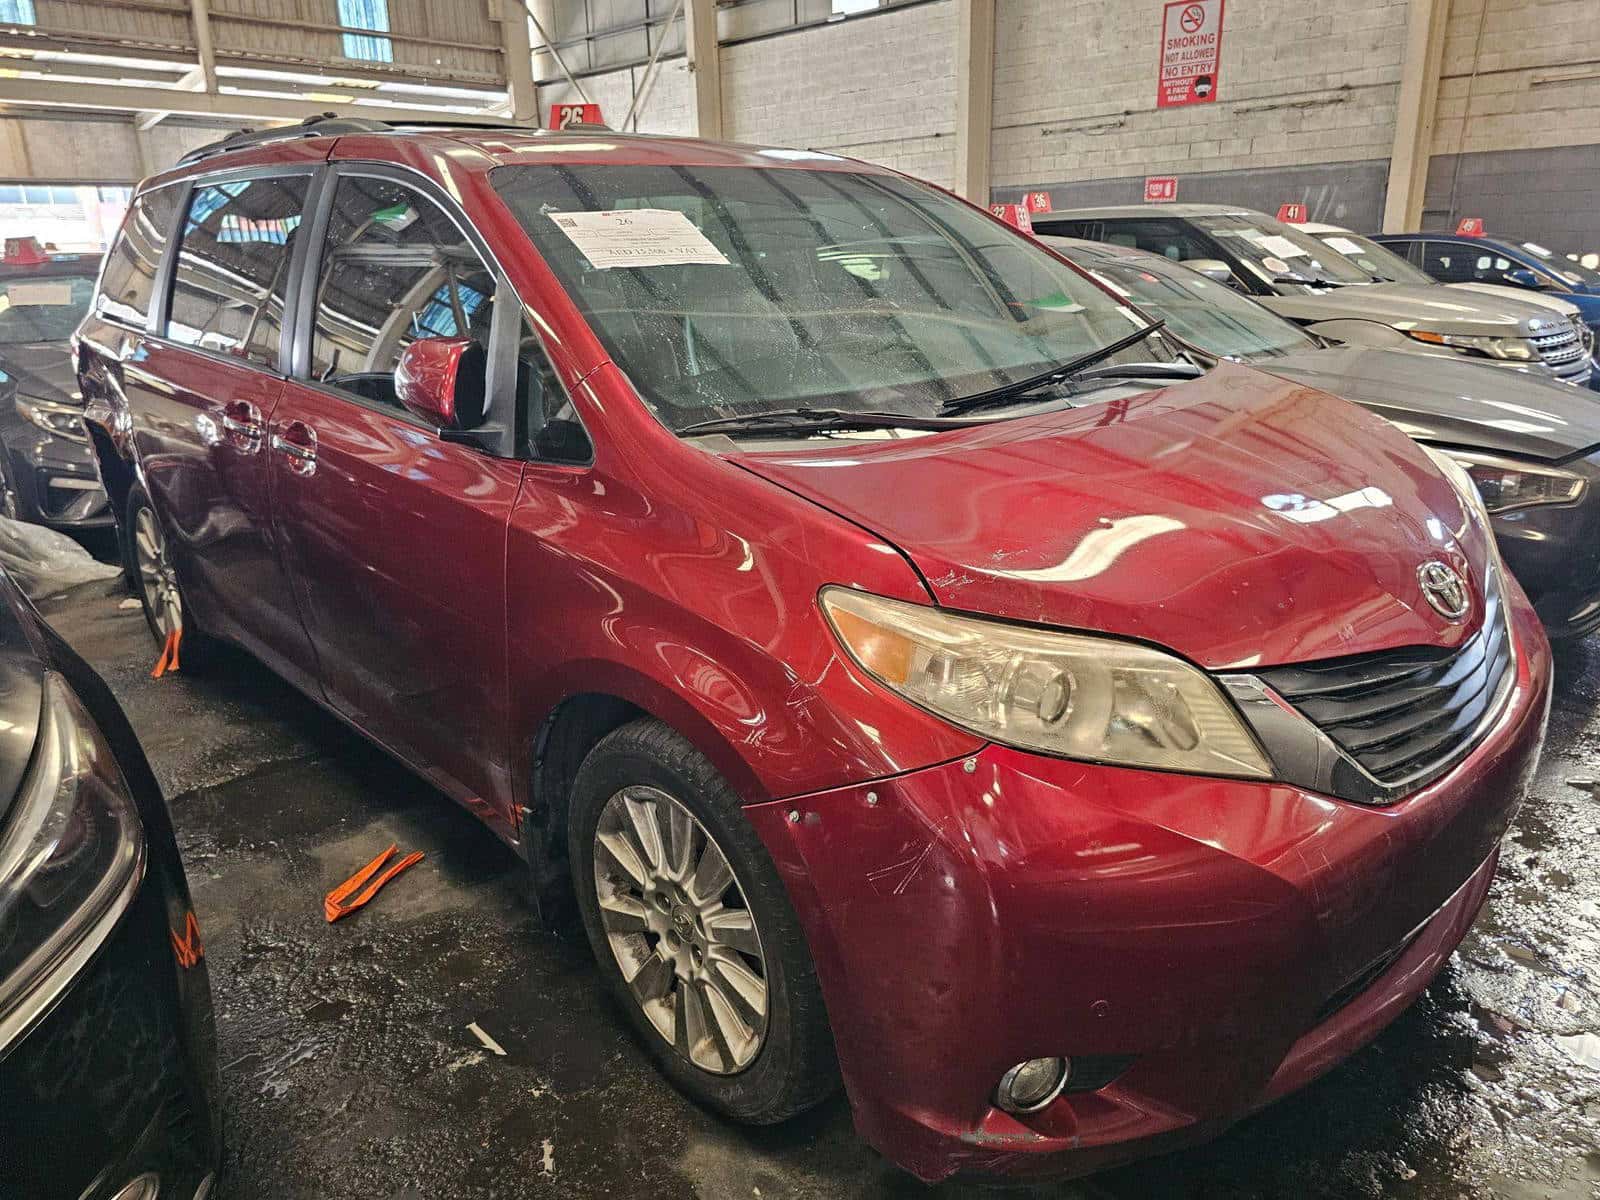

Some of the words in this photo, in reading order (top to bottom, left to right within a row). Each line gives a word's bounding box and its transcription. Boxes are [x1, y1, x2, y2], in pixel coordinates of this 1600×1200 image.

[1167, 33, 1215, 50] SMOKING
[1165, 52, 1179, 63] NOT
[1182, 48, 1215, 60] ALLOWED
[1165, 67, 1178, 77] NO
[1181, 63, 1212, 75] ENTRY
[560, 107, 583, 130] 26
[1287, 206, 1299, 219] 41
[615, 218, 633, 226] 26
